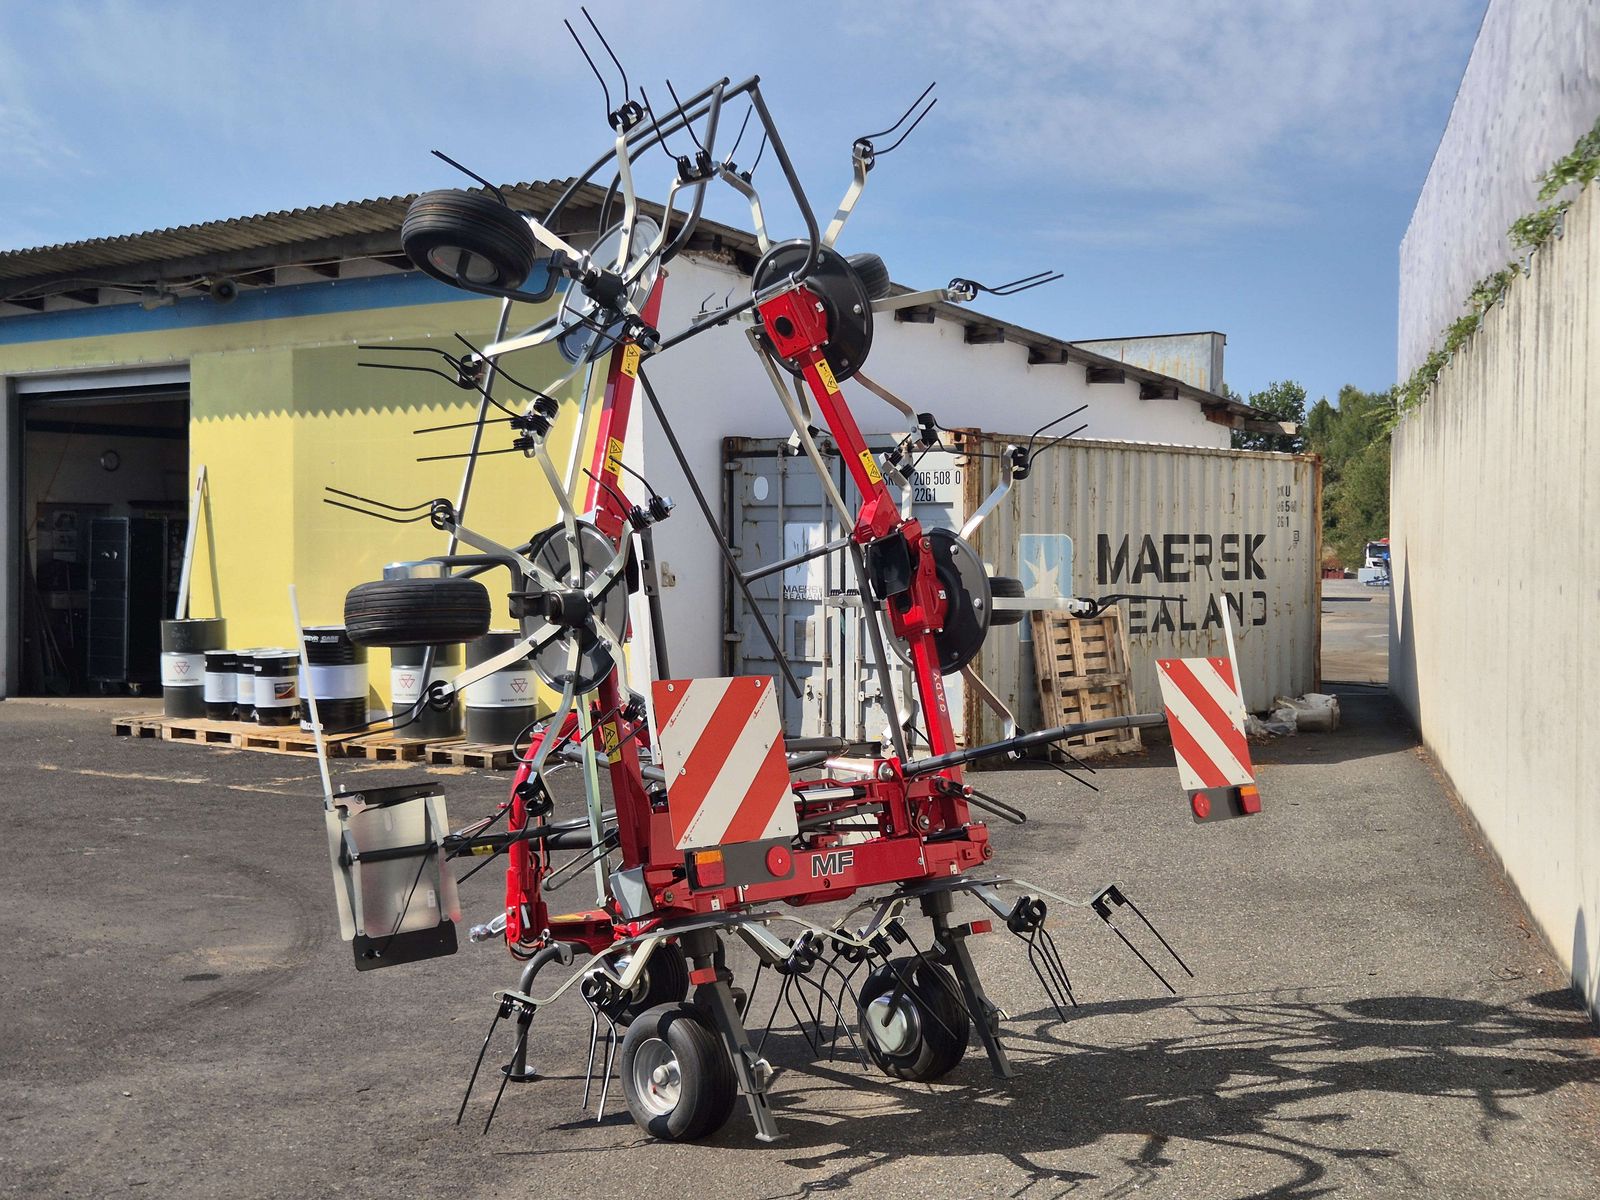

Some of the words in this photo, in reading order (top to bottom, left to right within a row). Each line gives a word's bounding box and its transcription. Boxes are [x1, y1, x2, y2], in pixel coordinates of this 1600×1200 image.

[914, 472, 931, 485] 206
[934, 471, 951, 485] 508
[955, 470, 961, 484] 0
[914, 488, 936, 501] 22G1
[1097, 534, 1267, 585] MAERSK
[1128, 590, 1267, 634] EALAND
[933, 672, 946, 713] GADY
[811, 849, 854, 878] MF
